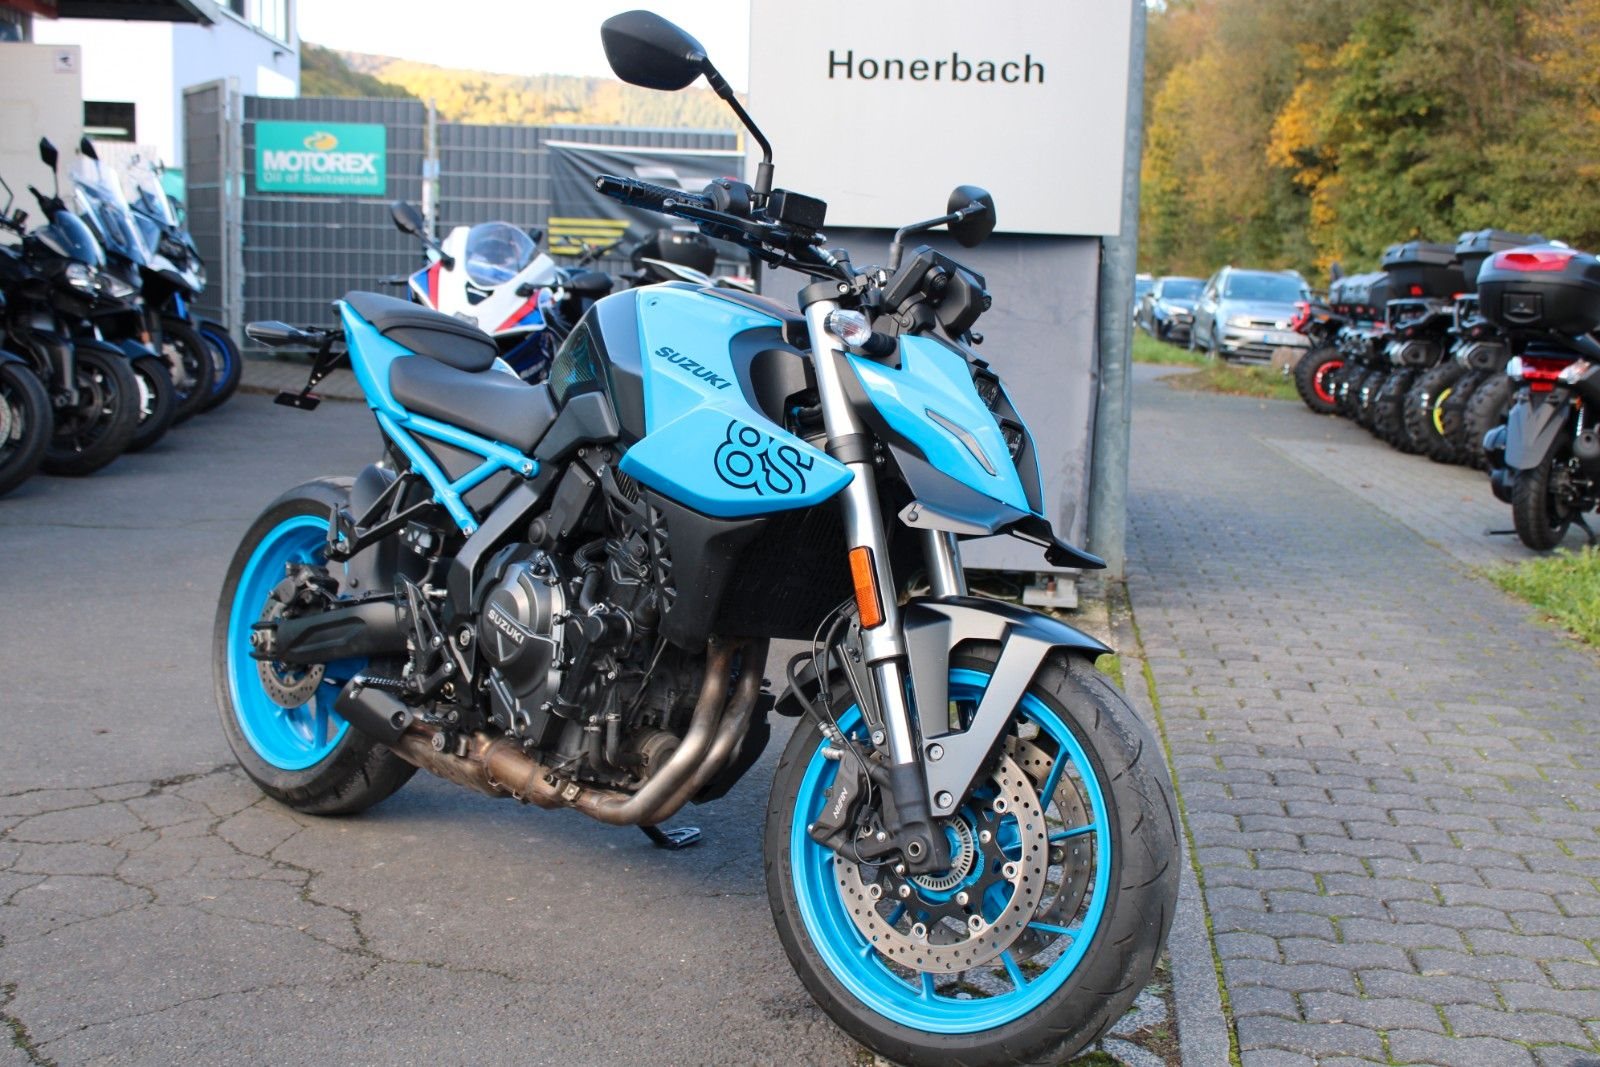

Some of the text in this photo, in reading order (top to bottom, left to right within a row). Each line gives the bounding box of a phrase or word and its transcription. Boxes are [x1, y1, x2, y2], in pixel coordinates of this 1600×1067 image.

[828, 49, 1045, 84] Honerbach
[263, 150, 377, 174] MOTOREX
[263, 171, 282, 184] Oil
[303, 172, 378, 187] Switzerland
[655, 346, 732, 390] SUZUKI
[488, 609, 525, 645] SUZUKI
